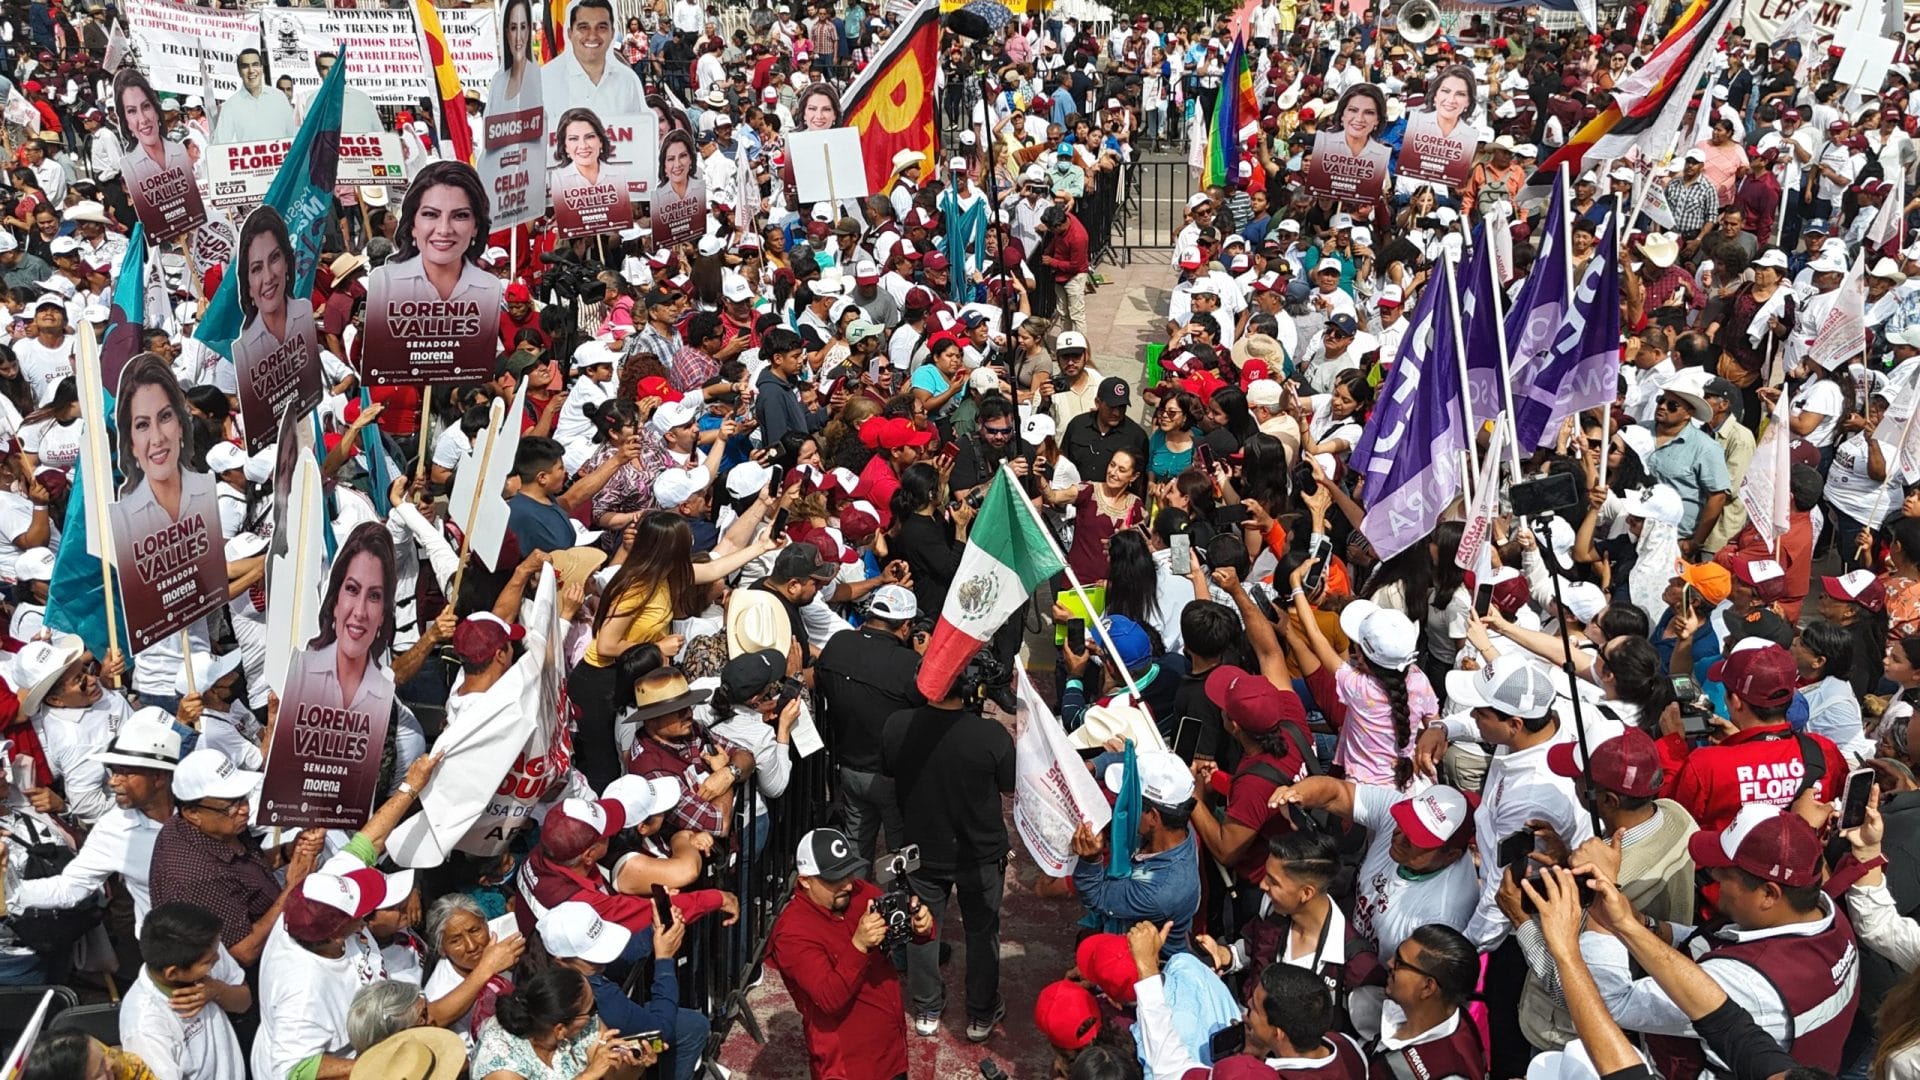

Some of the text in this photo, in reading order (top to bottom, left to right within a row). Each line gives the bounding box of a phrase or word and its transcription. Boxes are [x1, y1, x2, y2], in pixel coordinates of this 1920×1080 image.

[452, 11, 467, 20] DE
[134, 18, 178, 32] CUMPLIR
[181, 27, 201, 36] POR
[205, 30, 217, 38] LA
[195, 17, 259, 33] COMPROMISO
[319, 23, 340, 33] LOS
[345, 23, 389, 33] TRENES
[393, 24, 408, 33] DE
[452, 38, 472, 47] LOS
[367, 64, 380, 73] LA
[385, 79, 399, 87] DE
[401, 79, 427, 87] PLAN
[489, 120, 522, 139] SOMOS
[228, 140, 291, 157] RAMÓN
[341, 135, 379, 145] MÓN
[1415, 134, 1463, 151] LORENIA
[338, 146, 382, 157] ORES
[1413, 142, 1462, 161] VALLES
[1323, 153, 1374, 170] LORENIA
[140, 167, 184, 192] LORENIA
[1321, 162, 1374, 180] VALLES
[217, 185, 245, 194] VOTA
[495, 170, 529, 194] CELIDA
[145, 179, 189, 207] VALLES
[498, 190, 526, 210] LÓPEZ
[564, 184, 616, 199] LORENIA
[215, 196, 247, 206] SIGAMOS
[566, 193, 618, 210] VALLES
[660, 197, 698, 214] LORENIA
[661, 205, 699, 224] VALLES
[387, 301, 481, 318] LORENIA
[387, 318, 481, 338] VALLES
[406, 340, 460, 348] SENADORA
[1065, 337, 1073, 346] C
[250, 332, 306, 383] LORENIA
[410, 351, 454, 361] morena
[252, 345, 309, 400] VALLES
[268, 376, 301, 404] SENADORA
[1114, 383, 1125, 396] C
[1027, 421, 1035, 432] C
[133, 513, 207, 562] LORENIA
[137, 532, 210, 585] VALLES
[156, 564, 199, 592] SENADORA
[162, 579, 197, 605] morena
[296, 703, 371, 736] LORENIA
[294, 728, 370, 762] VALLES
[303, 762, 348, 776] SENADORA
[1737, 758, 1805, 782] RAMÓ
[303, 778, 341, 793] morena
[831, 839, 848, 858] C
[1408, 1047, 1430, 1080] morena
